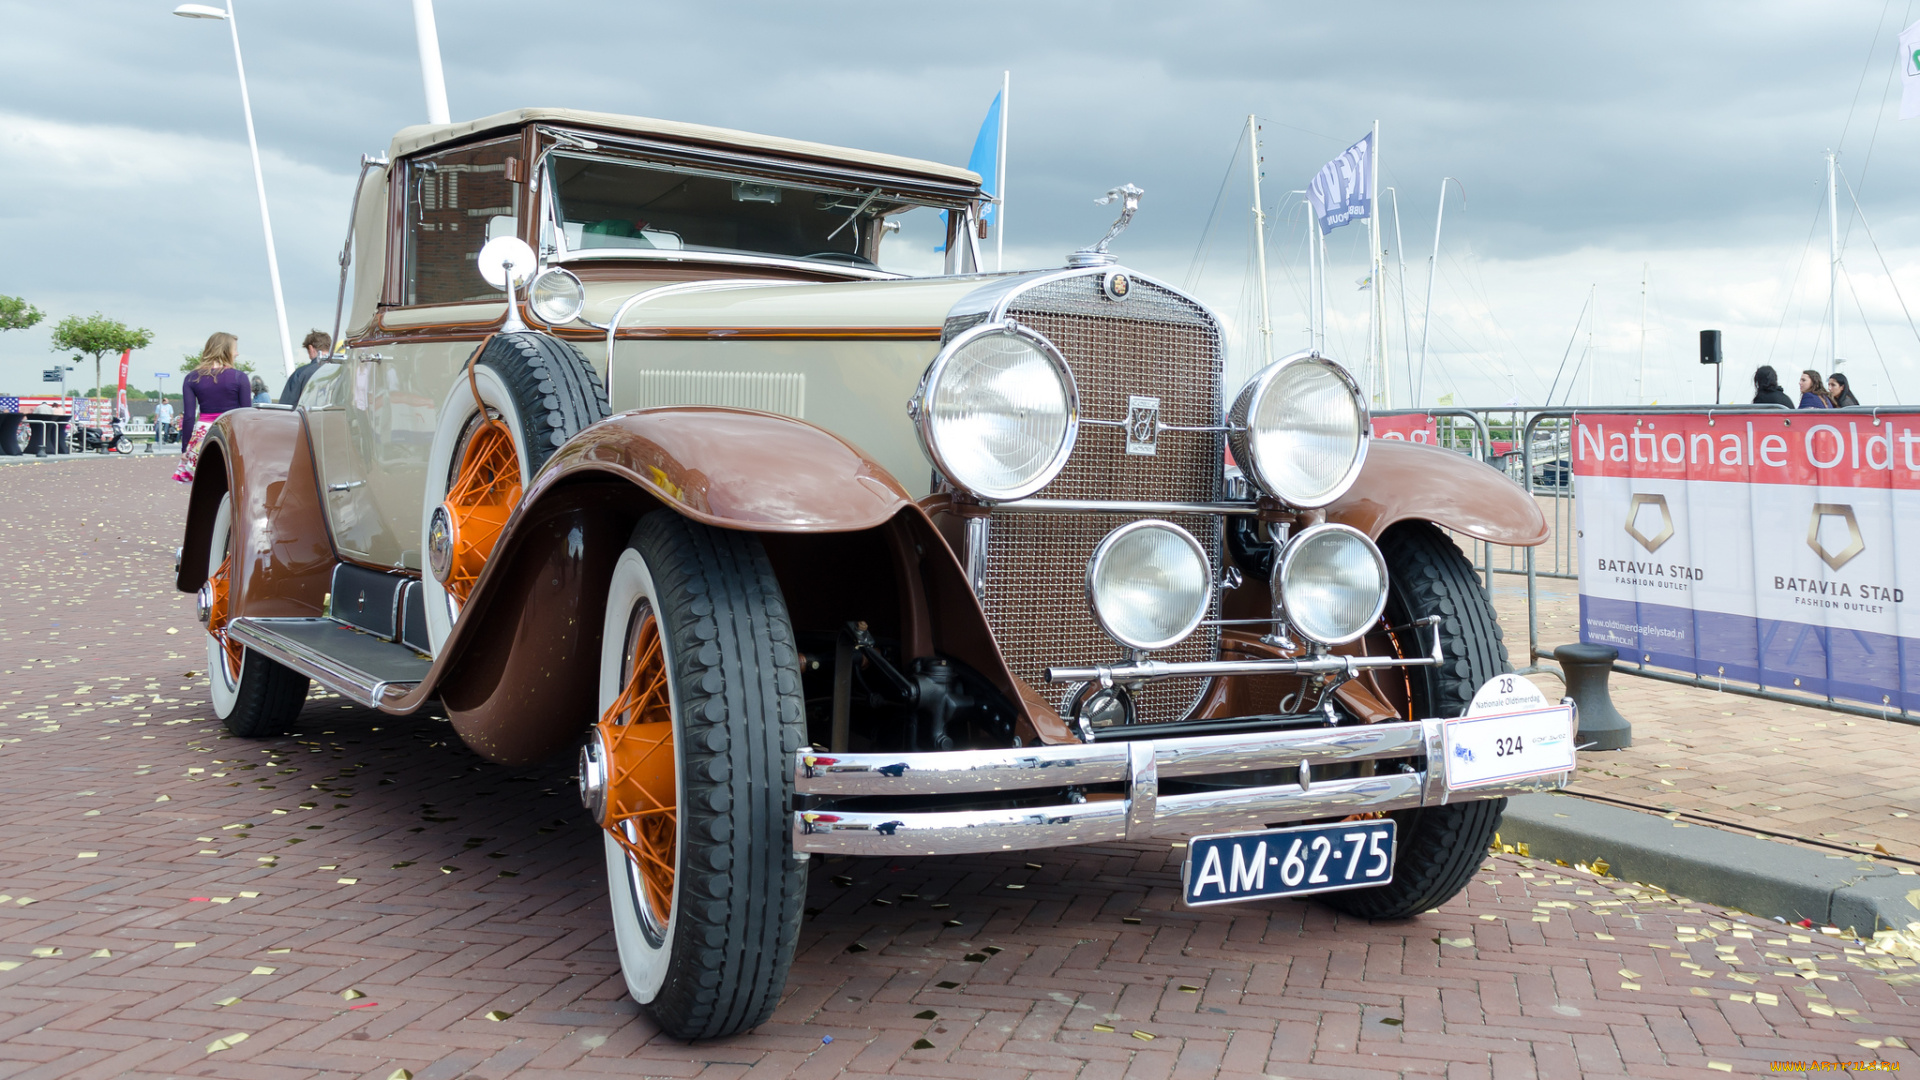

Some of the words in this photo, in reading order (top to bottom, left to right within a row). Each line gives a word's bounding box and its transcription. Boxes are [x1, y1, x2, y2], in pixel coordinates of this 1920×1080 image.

[1577, 421, 1788, 468] Nationale
[1803, 421, 1920, 472] Oldt
[1598, 558, 1664, 577] BATAVIA
[1670, 564, 1704, 581] STAD
[1615, 576, 1655, 587] FASHION
[1657, 580, 1688, 591] OUTLET
[1774, 576, 1852, 597] BATAVIA
[1859, 584, 1904, 603] STAD
[1795, 597, 1839, 609] FASHION
[1843, 602, 1884, 614] OUTLET
[1586, 618, 1685, 640] www.oldtimerdaglelystad.nl
[1475, 699, 1504, 709] Nationale
[1505, 694, 1541, 706] Oldtimerdag
[1496, 735, 1523, 757] 324
[1193, 830, 1389, 897] AM-62-75
